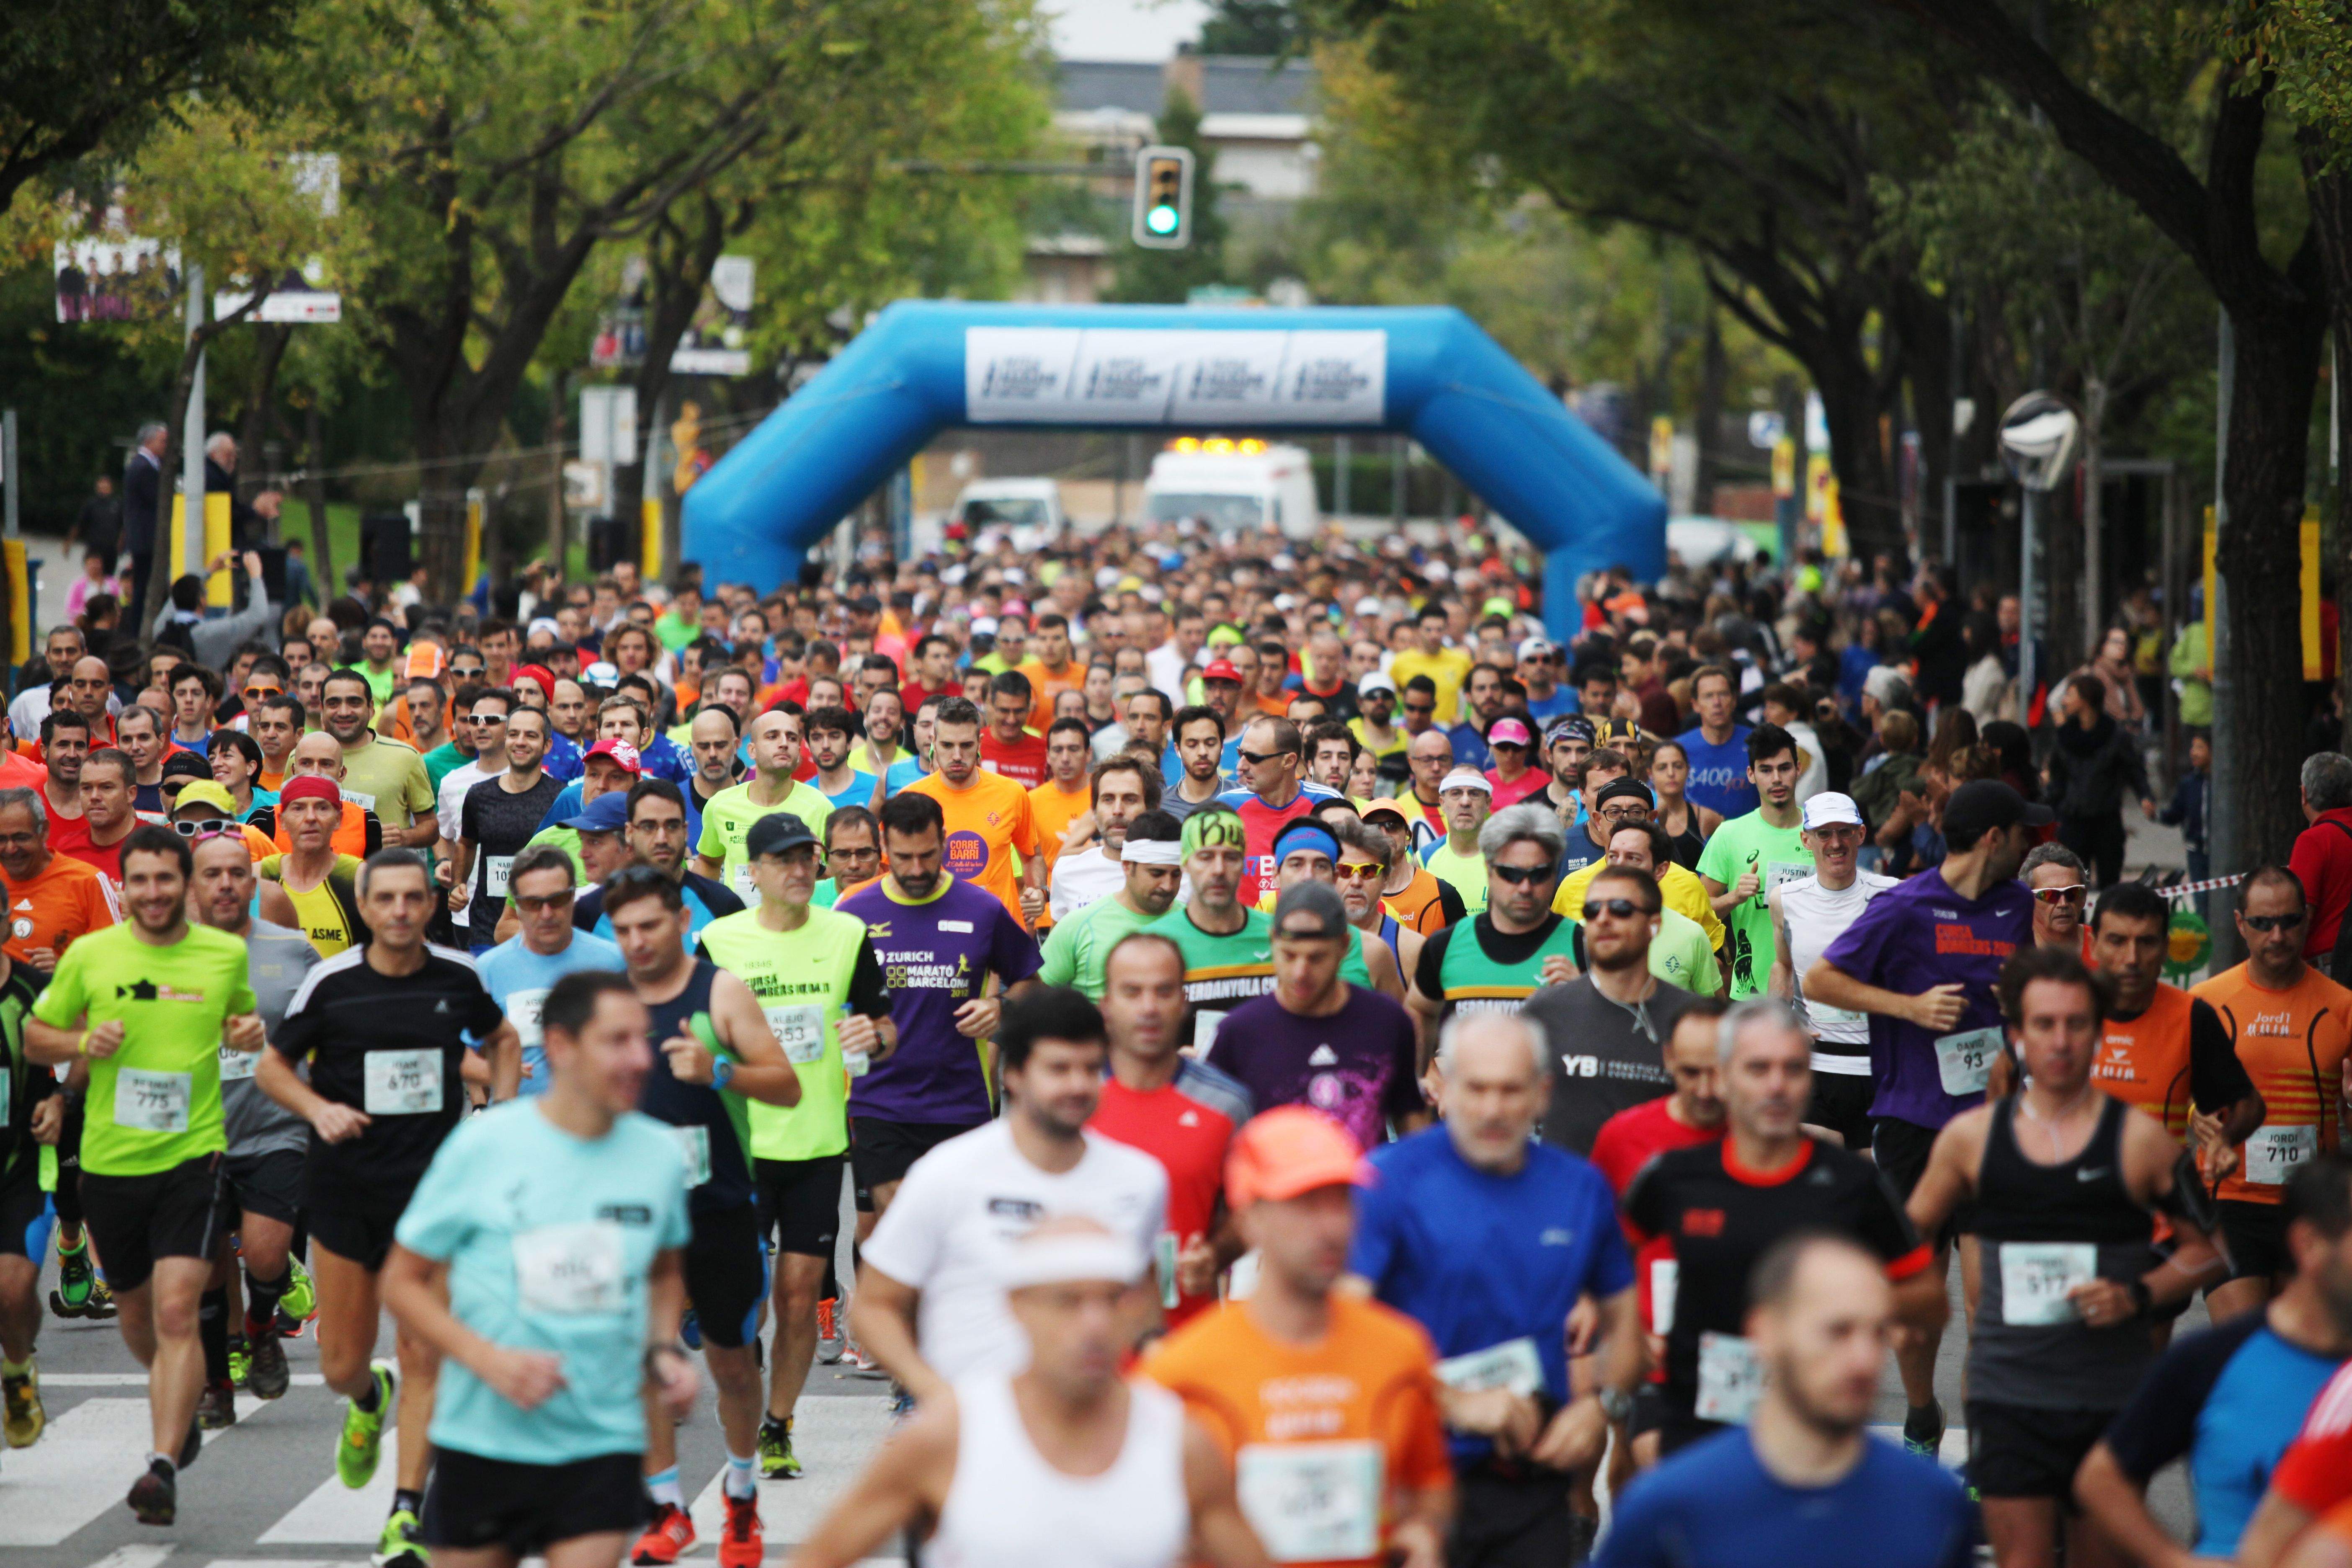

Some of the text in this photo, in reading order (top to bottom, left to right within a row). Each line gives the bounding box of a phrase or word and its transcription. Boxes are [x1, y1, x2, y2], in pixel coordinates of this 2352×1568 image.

[949, 840, 979, 850] CORRE
[949, 849, 979, 860] BARRI
[1781, 868, 1807, 877] JUSTIN
[312, 928, 343, 941] ASME
[886, 950, 934, 963] ZURICH
[906, 964, 955, 977] MARATÓ
[907, 976, 970, 988] BARCELONA
[774, 1026, 805, 1043] 253
[1957, 1039, 1985, 1052] DAVID
[1561, 1054, 1599, 1077] YB
[1964, 1052, 1983, 1070] 93
[388, 1073, 421, 1091] 670
[135, 1090, 170, 1110] 775
[2268, 1134, 2298, 1143] JORDI
[2267, 1146, 2298, 1162] 710
